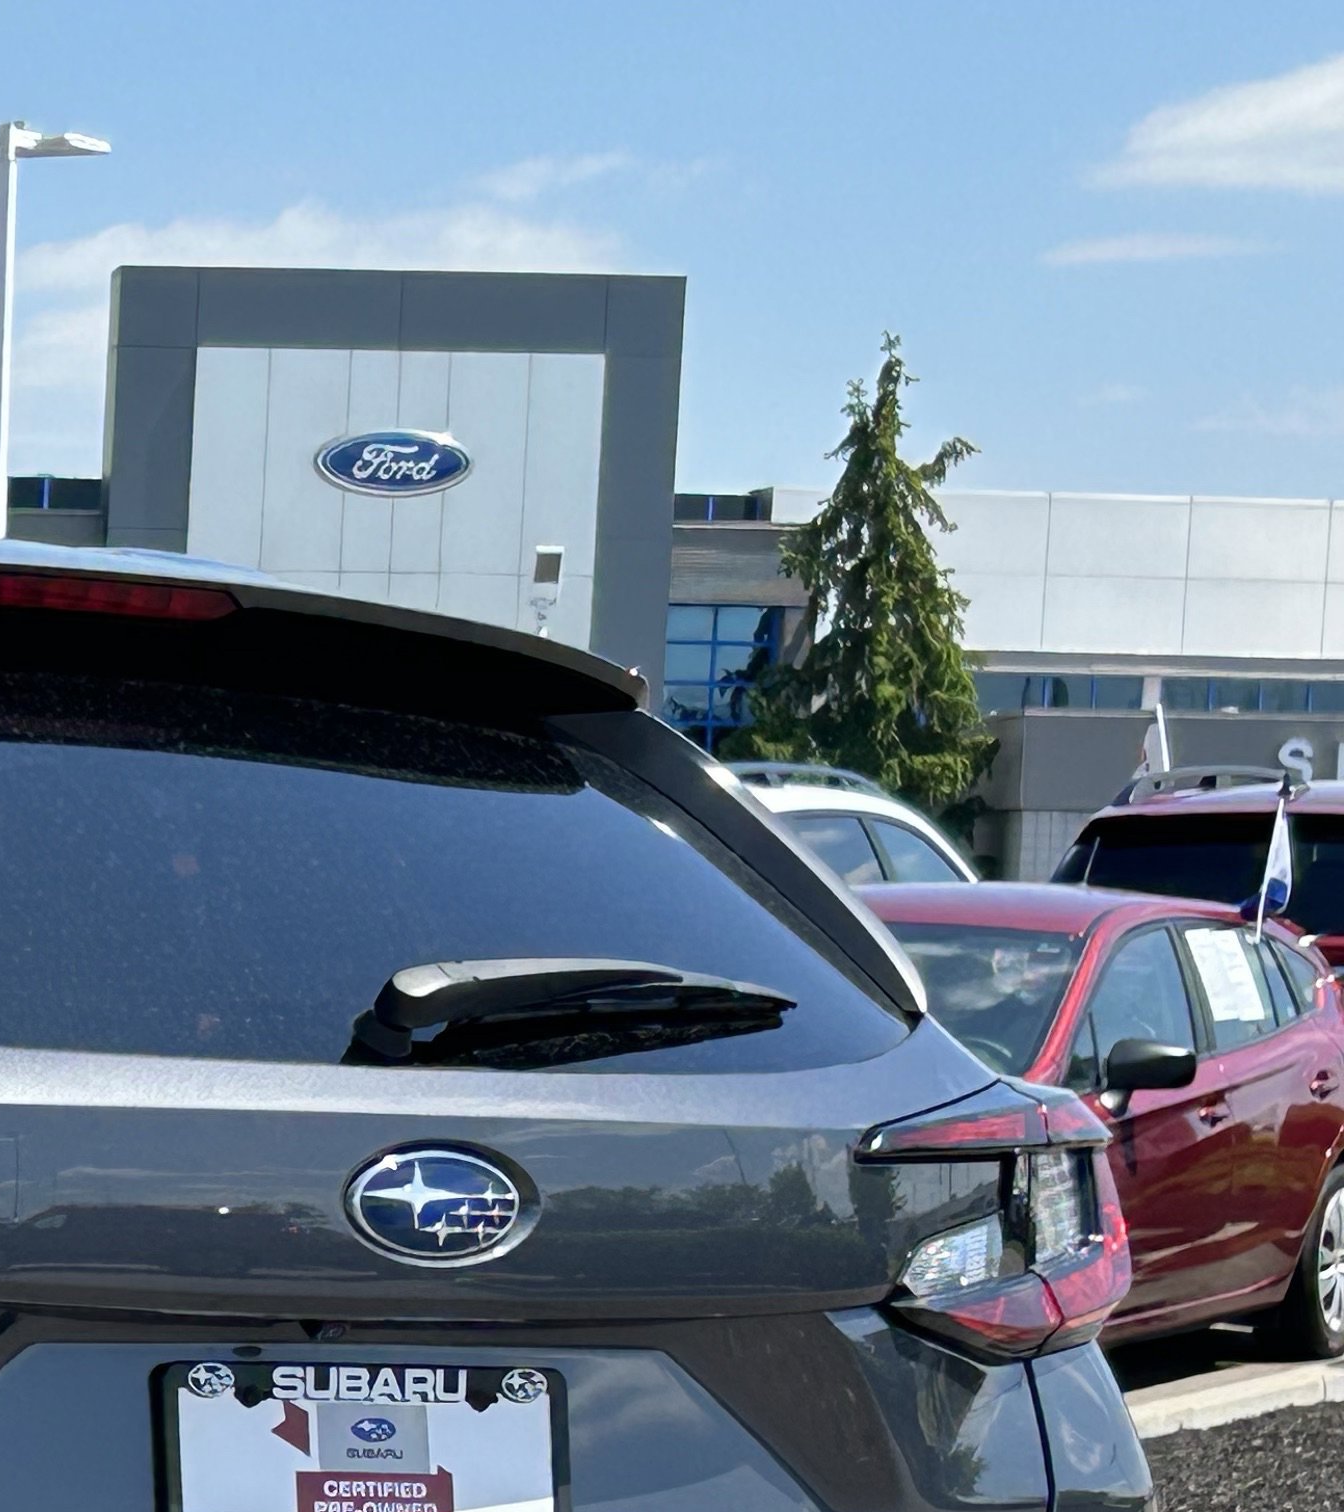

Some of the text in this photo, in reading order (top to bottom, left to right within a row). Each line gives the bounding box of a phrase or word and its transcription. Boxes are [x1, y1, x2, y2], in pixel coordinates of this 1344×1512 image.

[351, 443, 439, 481] Ford
[271, 1366, 468, 1404] SUBARU
[346, 1447, 404, 1460] SUBARU
[323, 1480, 427, 1498] CERTIFIED
